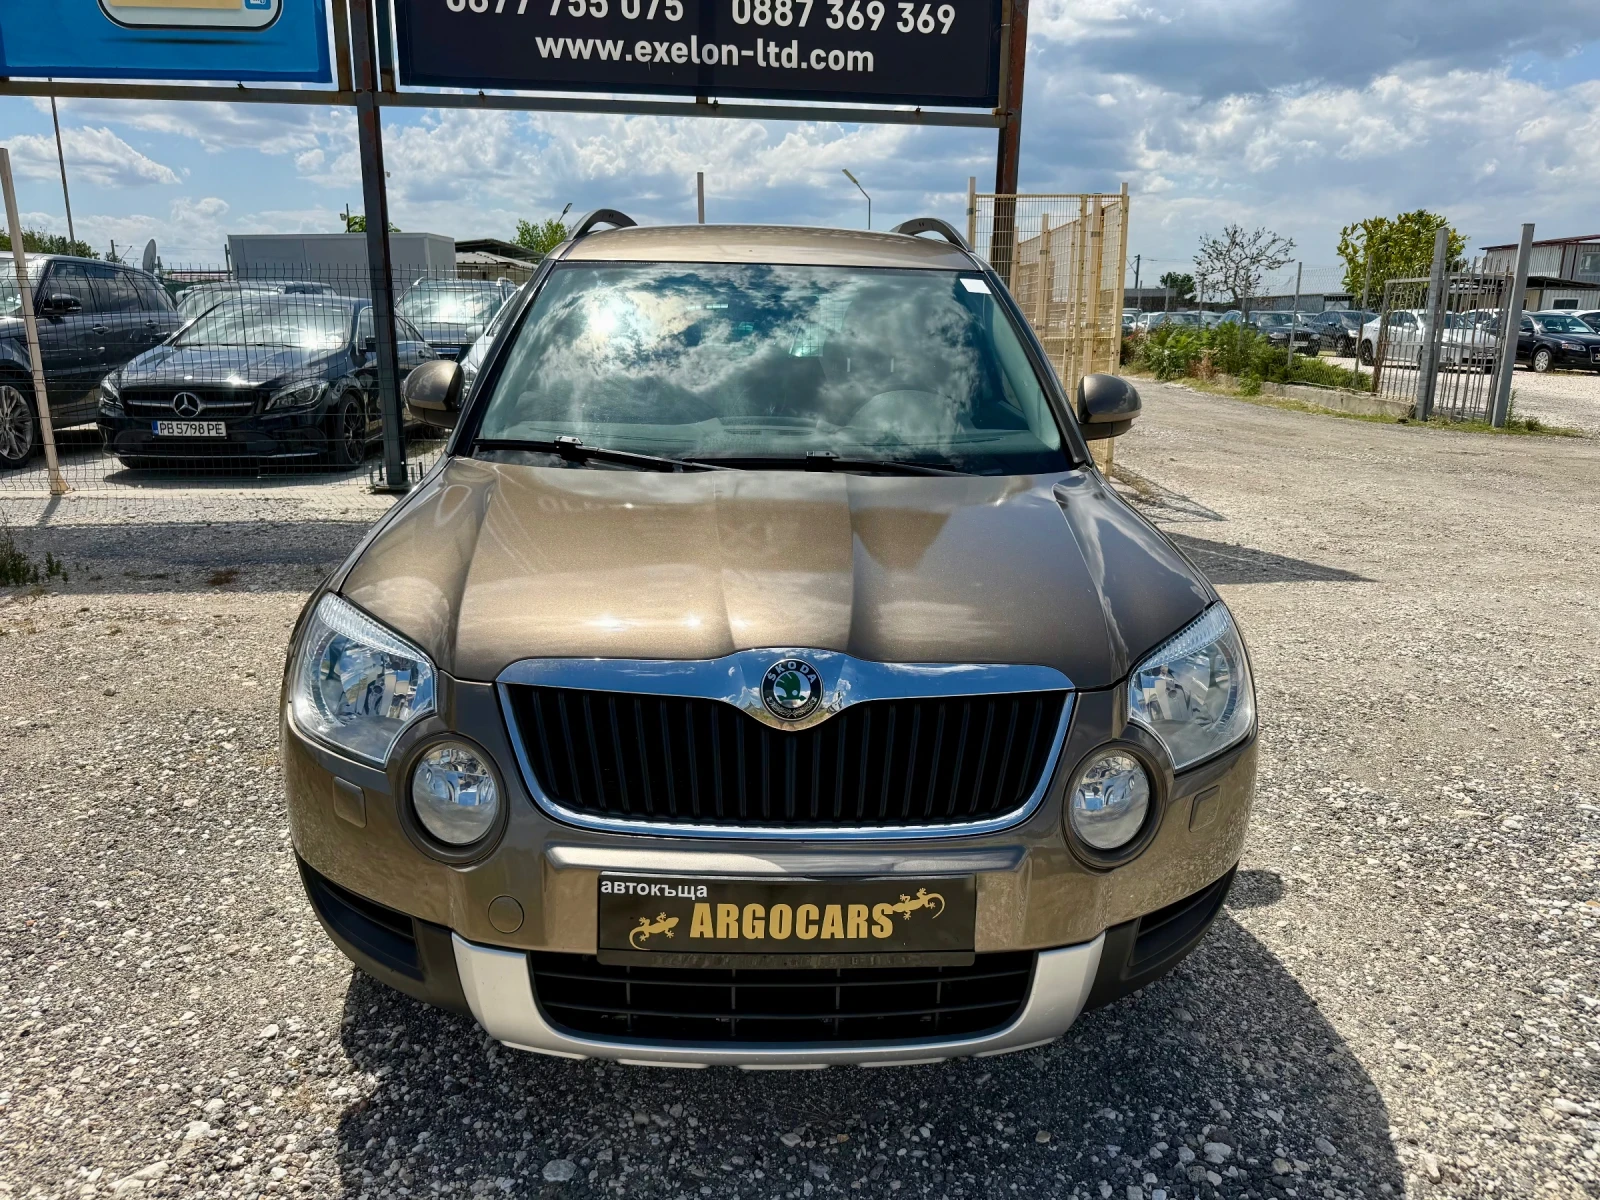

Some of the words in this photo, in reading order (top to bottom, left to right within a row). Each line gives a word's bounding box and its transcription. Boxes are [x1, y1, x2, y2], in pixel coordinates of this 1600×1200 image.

[620, 0, 684, 22] 075
[731, 0, 814, 28] 0887
[825, 0, 886, 31] 369
[896, 2, 956, 34] 369
[534, 35, 874, 73] www.exelon-ltd.com
[159, 423, 174, 435] PB
[176, 423, 205, 435] 5798
[206, 423, 224, 435] PE
[600, 880, 708, 901] автокъща
[689, 902, 895, 941] ARGOCARS
